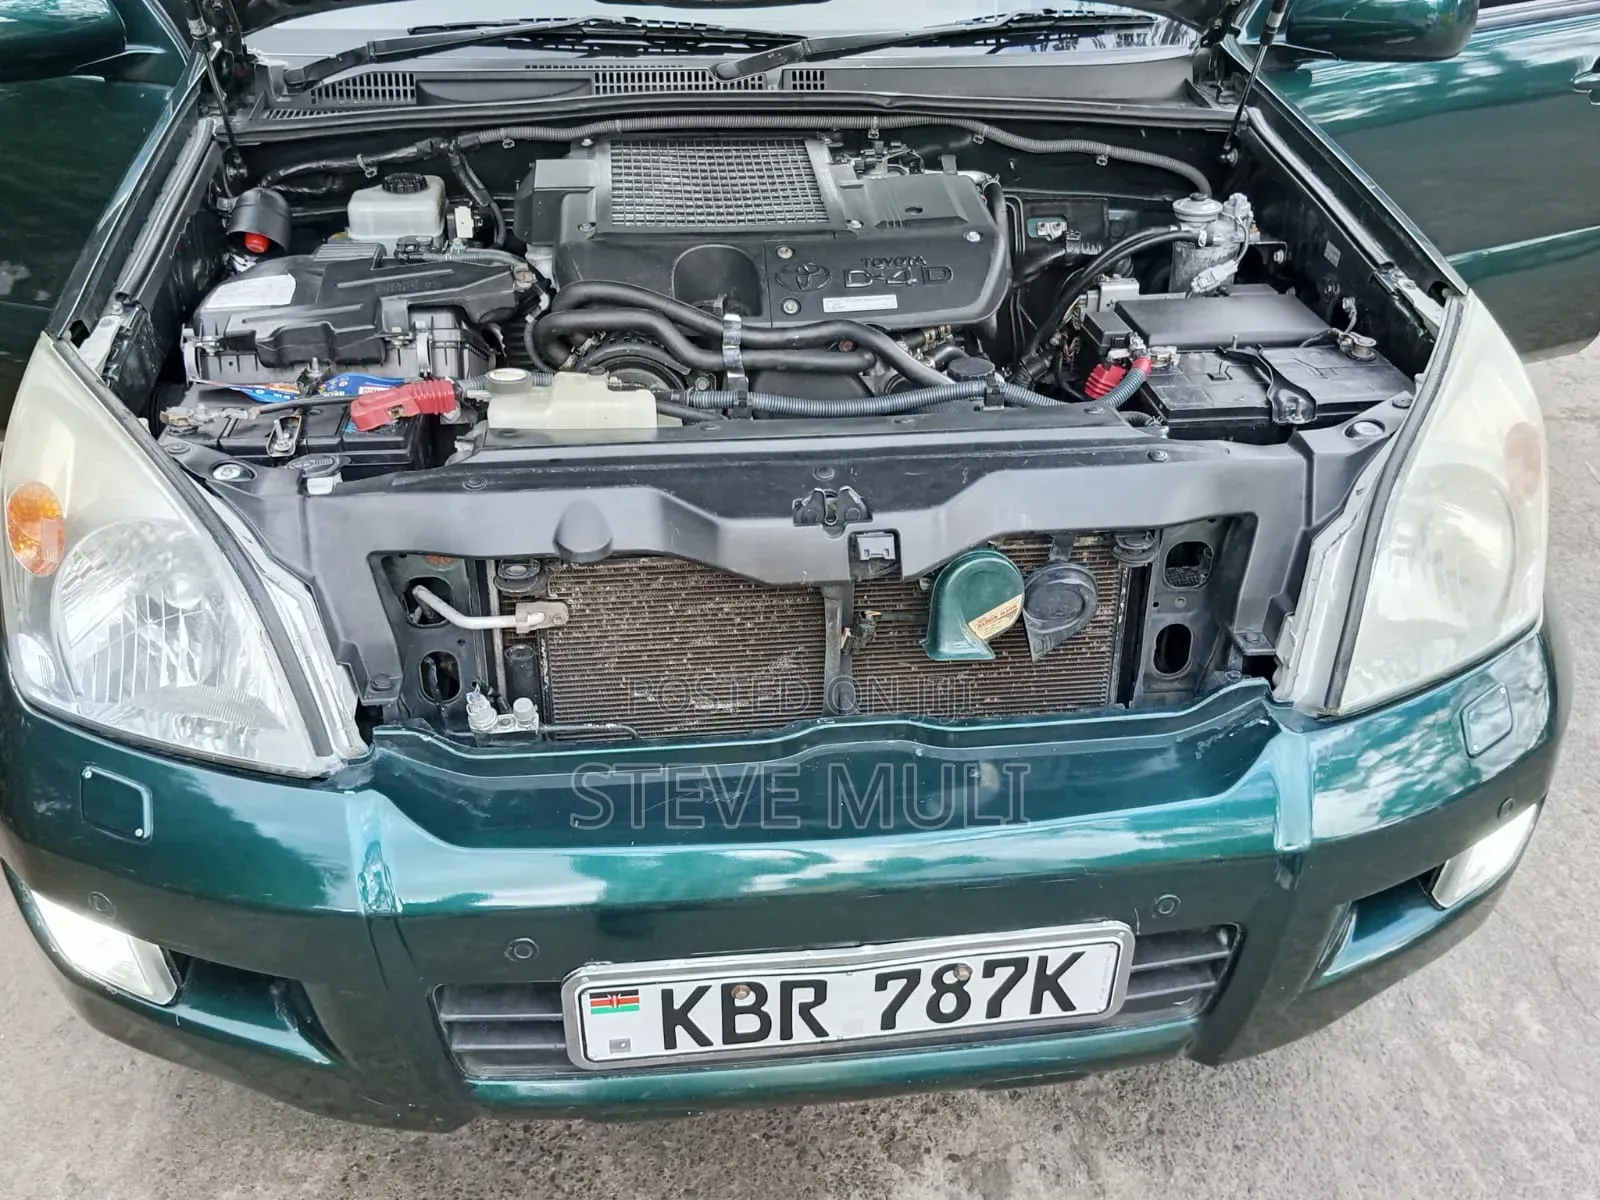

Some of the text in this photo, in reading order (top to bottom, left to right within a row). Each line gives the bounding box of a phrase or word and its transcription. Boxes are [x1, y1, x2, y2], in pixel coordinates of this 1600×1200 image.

[861, 255, 927, 270] TOYOTA
[842, 265, 954, 289] D-4D
[660, 978, 830, 1051] KBR
[873, 950, 1086, 1033] 787K
